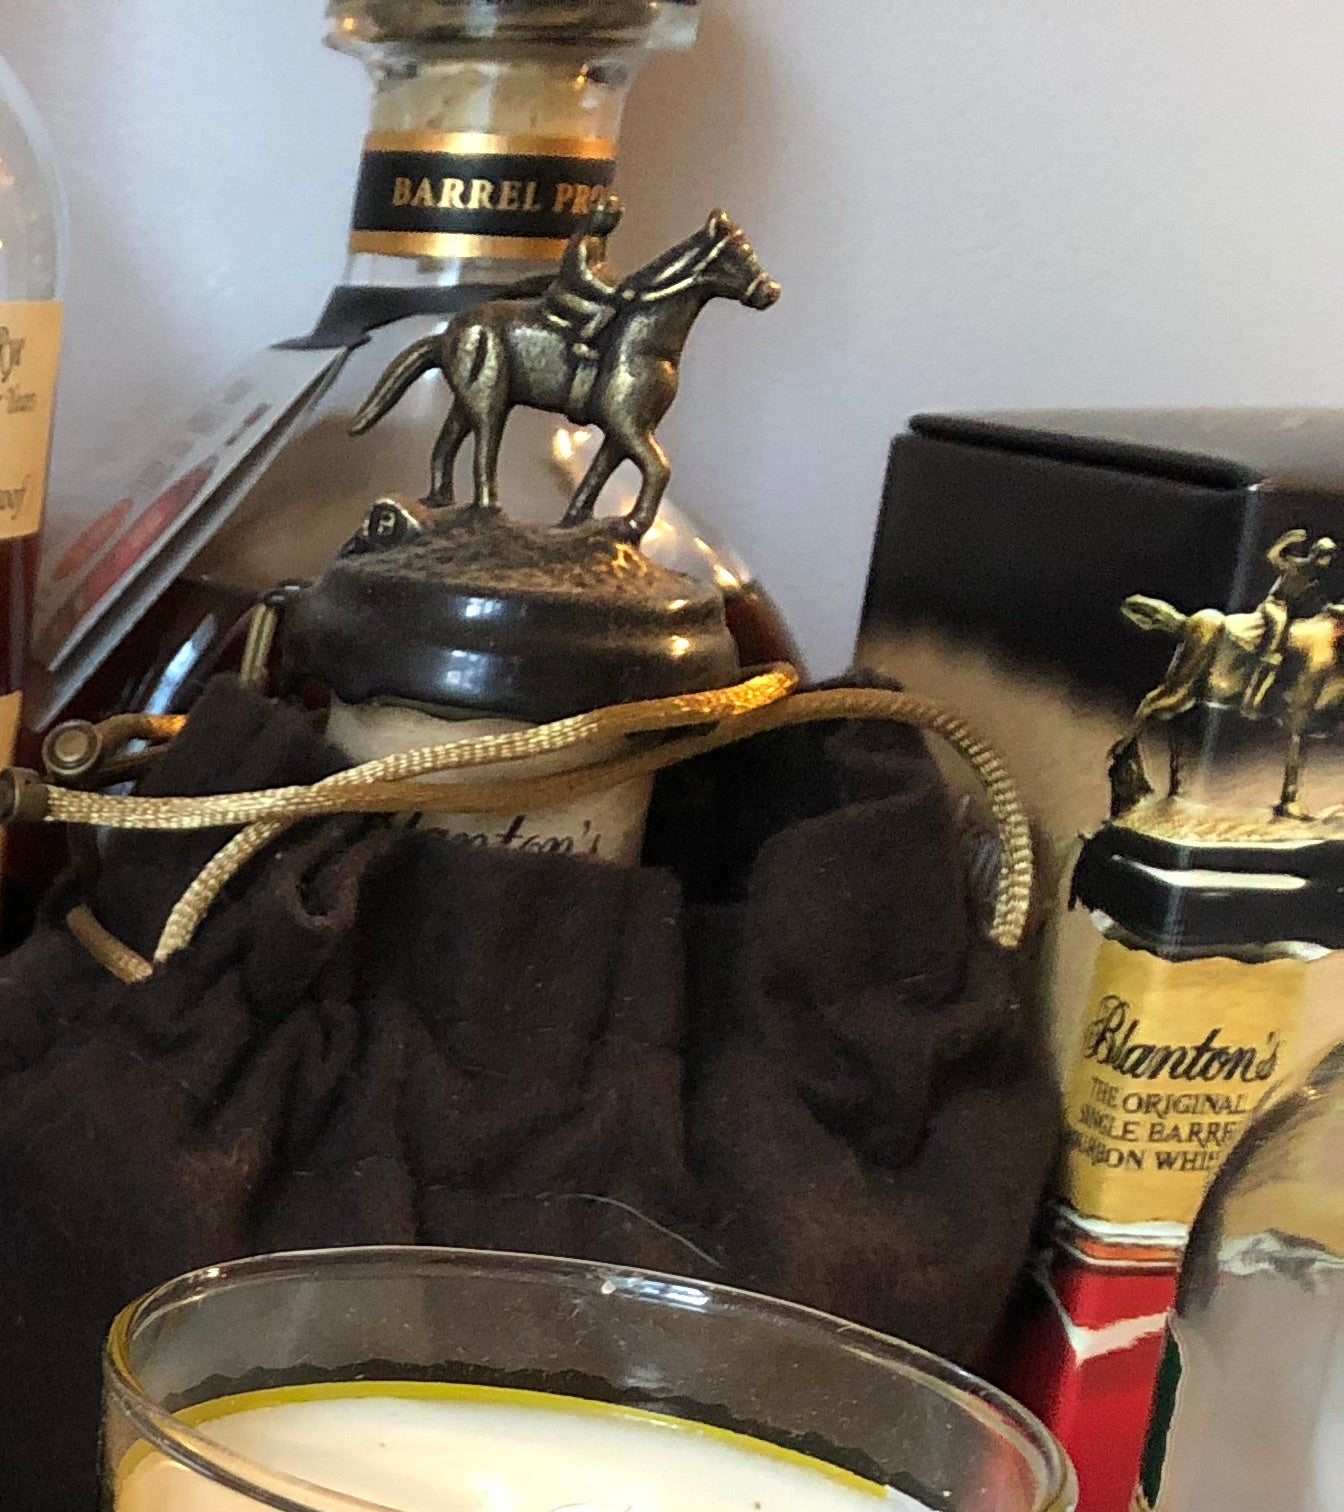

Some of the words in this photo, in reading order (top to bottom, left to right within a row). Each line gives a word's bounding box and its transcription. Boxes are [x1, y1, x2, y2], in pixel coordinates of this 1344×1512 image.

[392, 176, 540, 211] BARREL
[1084, 995, 1286, 1083] Blanton's
[1122, 1092, 1251, 1120] ORIGINAL
